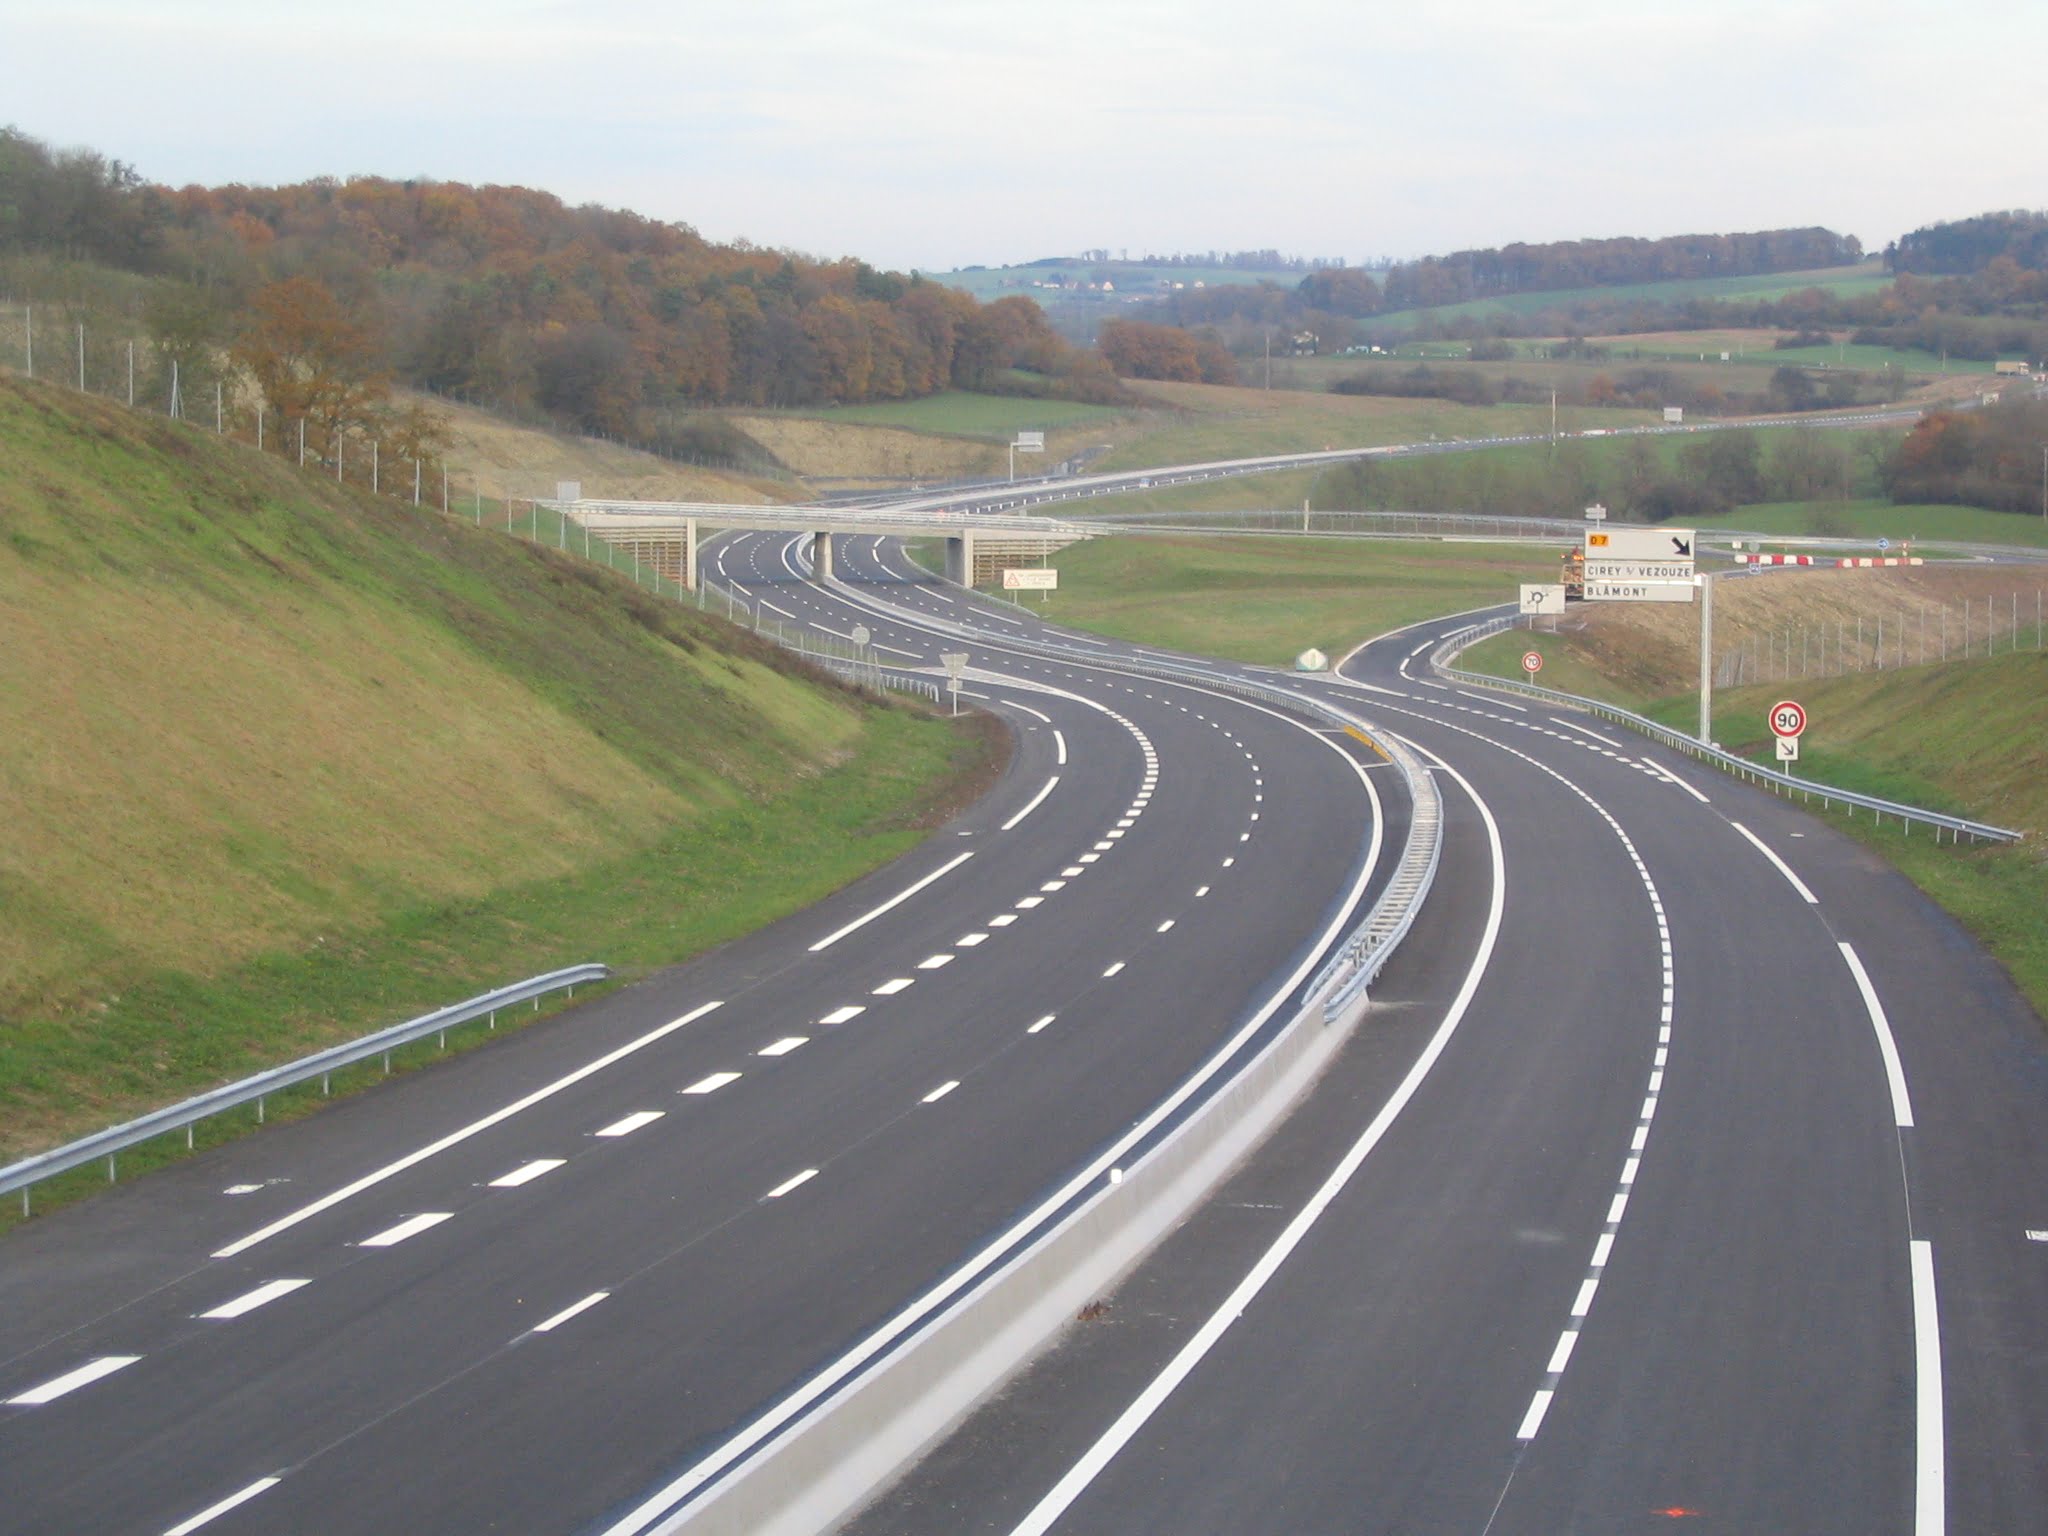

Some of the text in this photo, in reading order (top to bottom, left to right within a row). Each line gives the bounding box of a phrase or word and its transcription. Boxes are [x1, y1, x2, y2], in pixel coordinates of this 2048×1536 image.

[1588, 566, 1622, 576] CIREY
[1638, 567, 1691, 577] VEZOUZE
[1587, 585, 1647, 597] BLÂMONT
[1528, 658, 1538, 666] 70
[1777, 713, 1798, 728] 90
